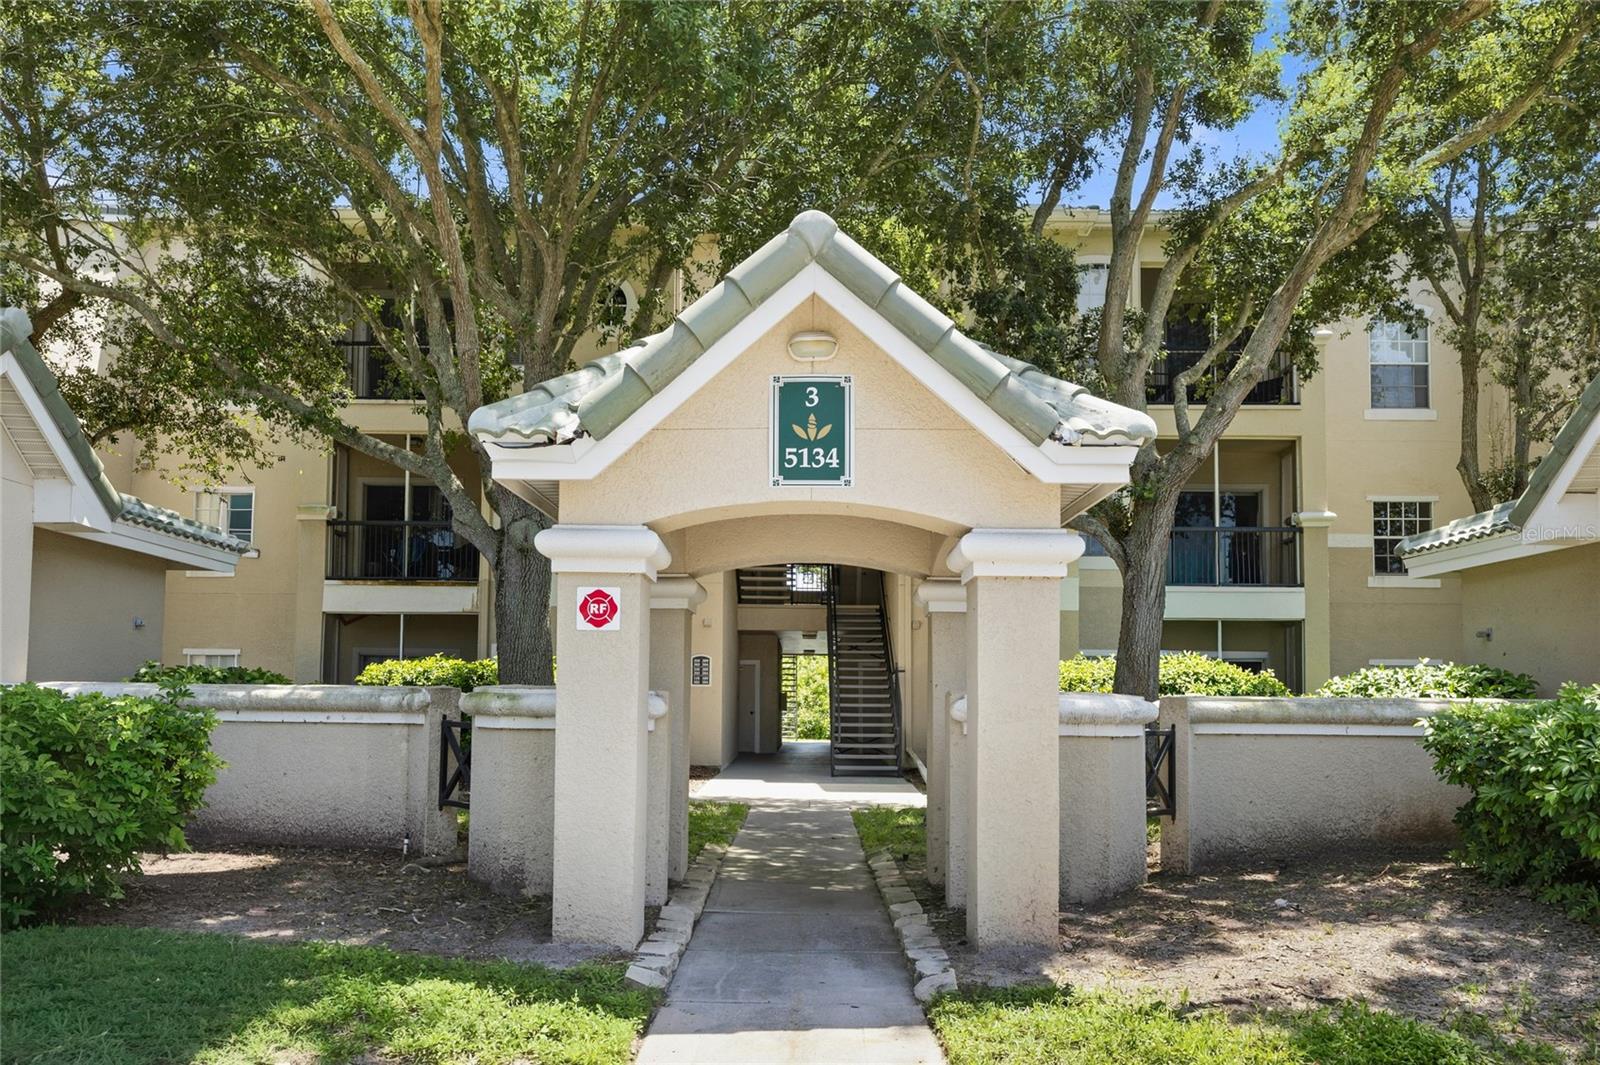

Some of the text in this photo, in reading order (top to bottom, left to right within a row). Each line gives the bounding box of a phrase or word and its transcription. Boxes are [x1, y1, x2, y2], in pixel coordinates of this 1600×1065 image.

[805, 386, 819, 407] 3
[784, 447, 840, 468] 5134
[590, 603, 607, 614] RF
